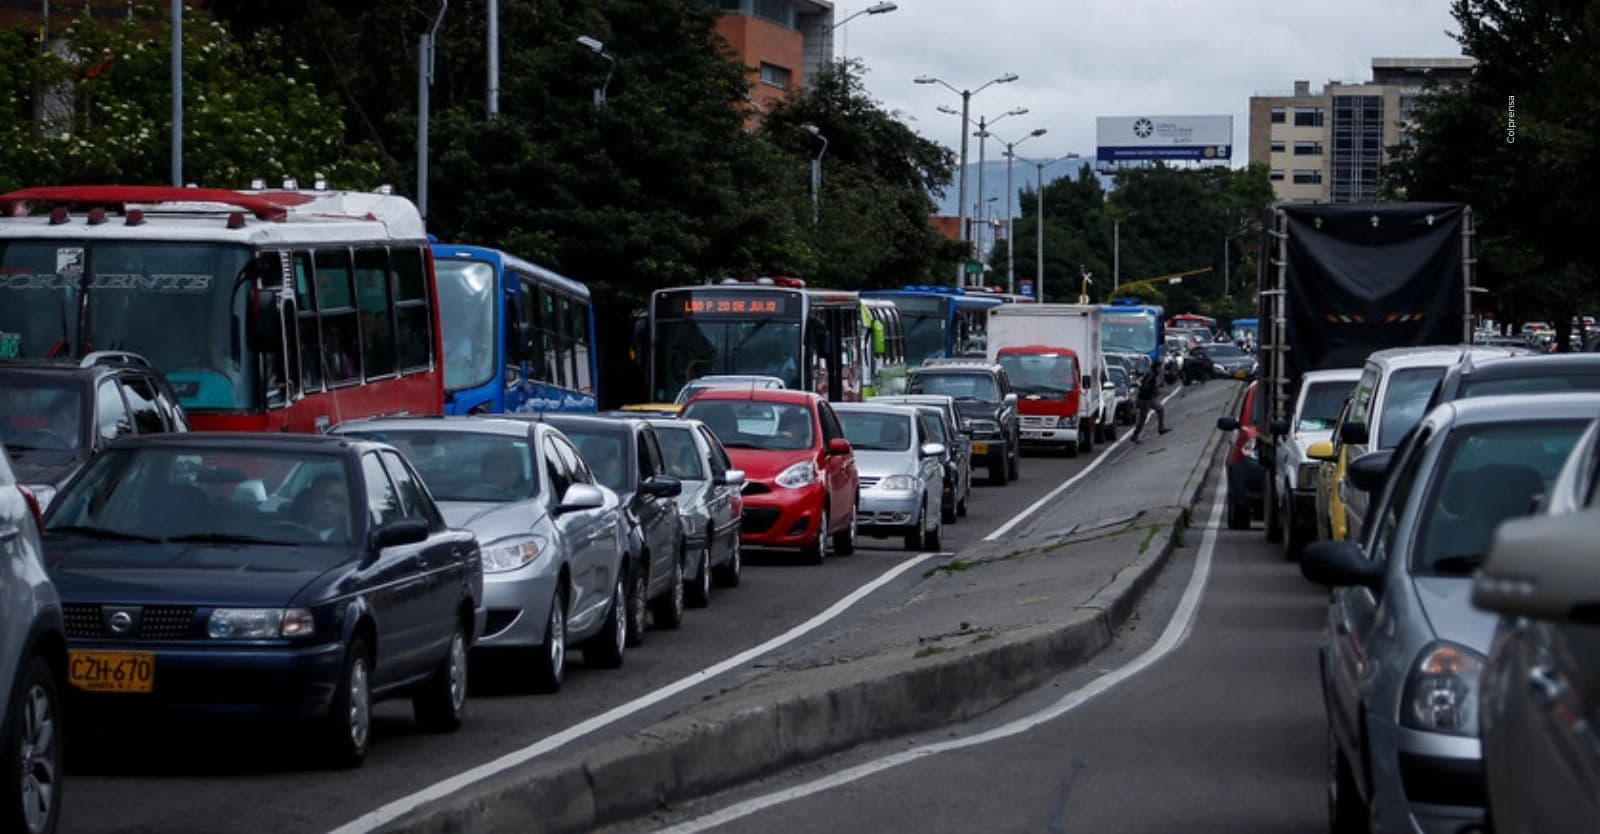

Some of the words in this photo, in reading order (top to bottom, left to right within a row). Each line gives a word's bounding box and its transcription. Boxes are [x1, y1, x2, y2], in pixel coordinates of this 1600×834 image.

[718, 300, 730, 312] 20
[733, 300, 746, 312] DE
[749, 300, 776, 312] JULIO
[71, 657, 151, 682] CZH-670
